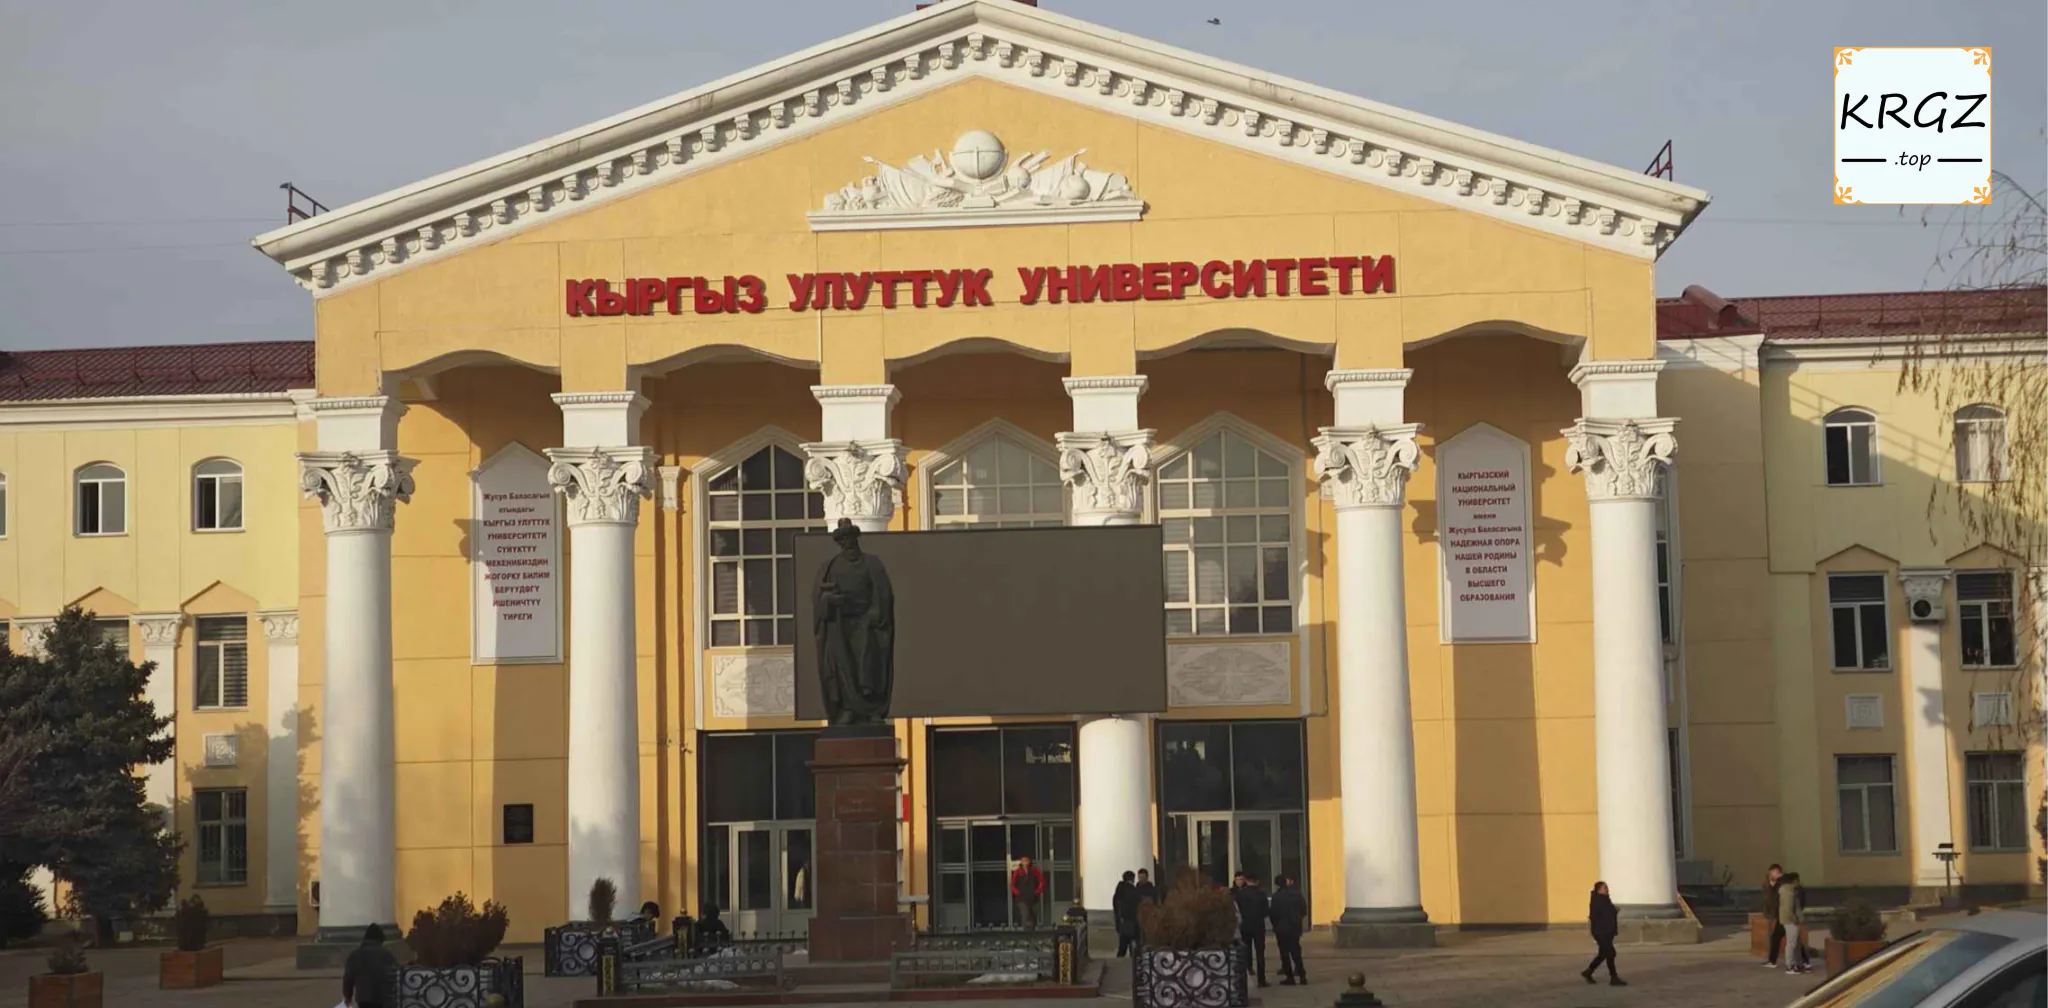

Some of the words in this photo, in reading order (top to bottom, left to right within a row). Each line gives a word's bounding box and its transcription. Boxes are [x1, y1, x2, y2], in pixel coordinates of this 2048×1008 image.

[565, 275, 767, 317] КЫРГЫЗ
[787, 268, 994, 312] УЛУТТУК
[1018, 255, 1396, 306] УНИВЕРСИТЕТИ
[1457, 470, 1510, 479] КЫРГЫЗСКИЙ
[1452, 483, 1516, 494] НАЦИОНАЛЬНЫЙ
[483, 493, 508, 502] Жусуп
[509, 492, 551, 500] Баласагын
[1457, 497, 1511, 507] УНИВЕРСИТЕТ
[483, 519, 516, 527] КЫРГЫЗ
[517, 518, 551, 526] УЛУТТУК
[487, 532, 548, 540] УНИВЕРСИТЕТИ
[1450, 539, 1493, 547] НАДЕЖНАЯ
[1494, 538, 1520, 546] ОПОРА
[1455, 552, 1482, 560] НАШЕЙ
[1484, 552, 1517, 560] РОДИНЫ
[486, 558, 549, 567] МЕКЕНИБИЗДИН
[1472, 566, 1508, 574] ОБЛАСТИ
[522, 571, 550, 579] БИЛИМ
[1467, 579, 1506, 588] ВЫСШЕГО
[1460, 593, 1516, 601] ОБРАЗОВАНИЯ
[503, 612, 533, 620] ТИРЕГИ
